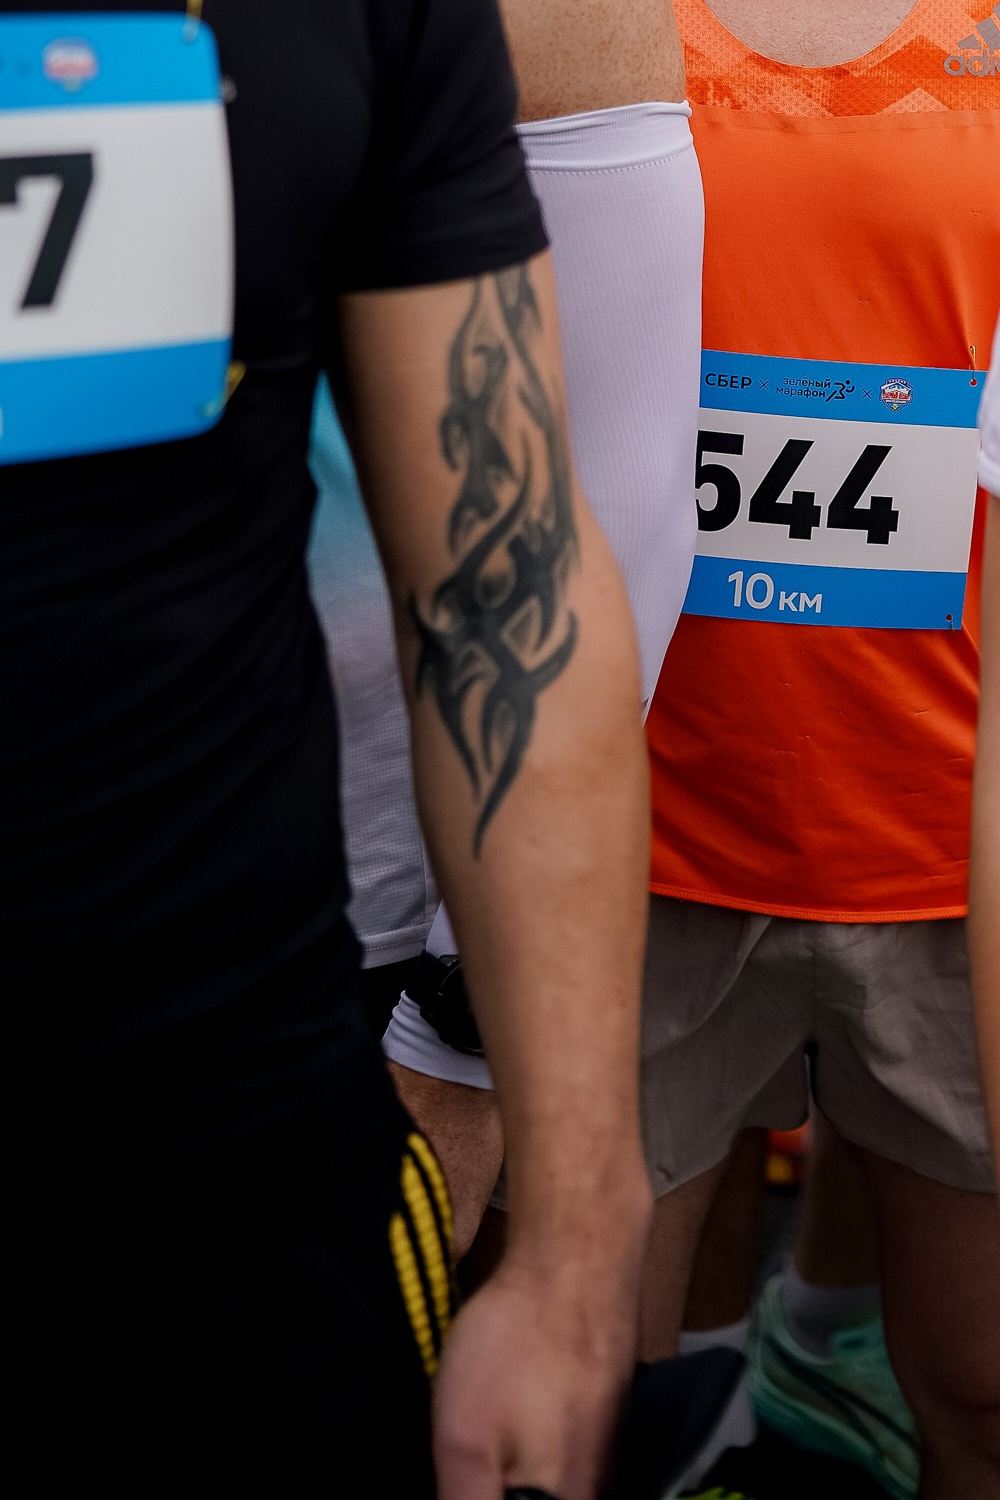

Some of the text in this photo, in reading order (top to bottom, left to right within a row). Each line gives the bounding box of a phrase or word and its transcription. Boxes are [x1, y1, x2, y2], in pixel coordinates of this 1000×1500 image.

[0, 152, 95, 309] 7
[705, 373, 752, 389] СБЕР
[776, 387, 826, 398] марафон
[783, 377, 831, 388] зелёный
[694, 429, 899, 545] 544
[727, 570, 774, 610] 10
